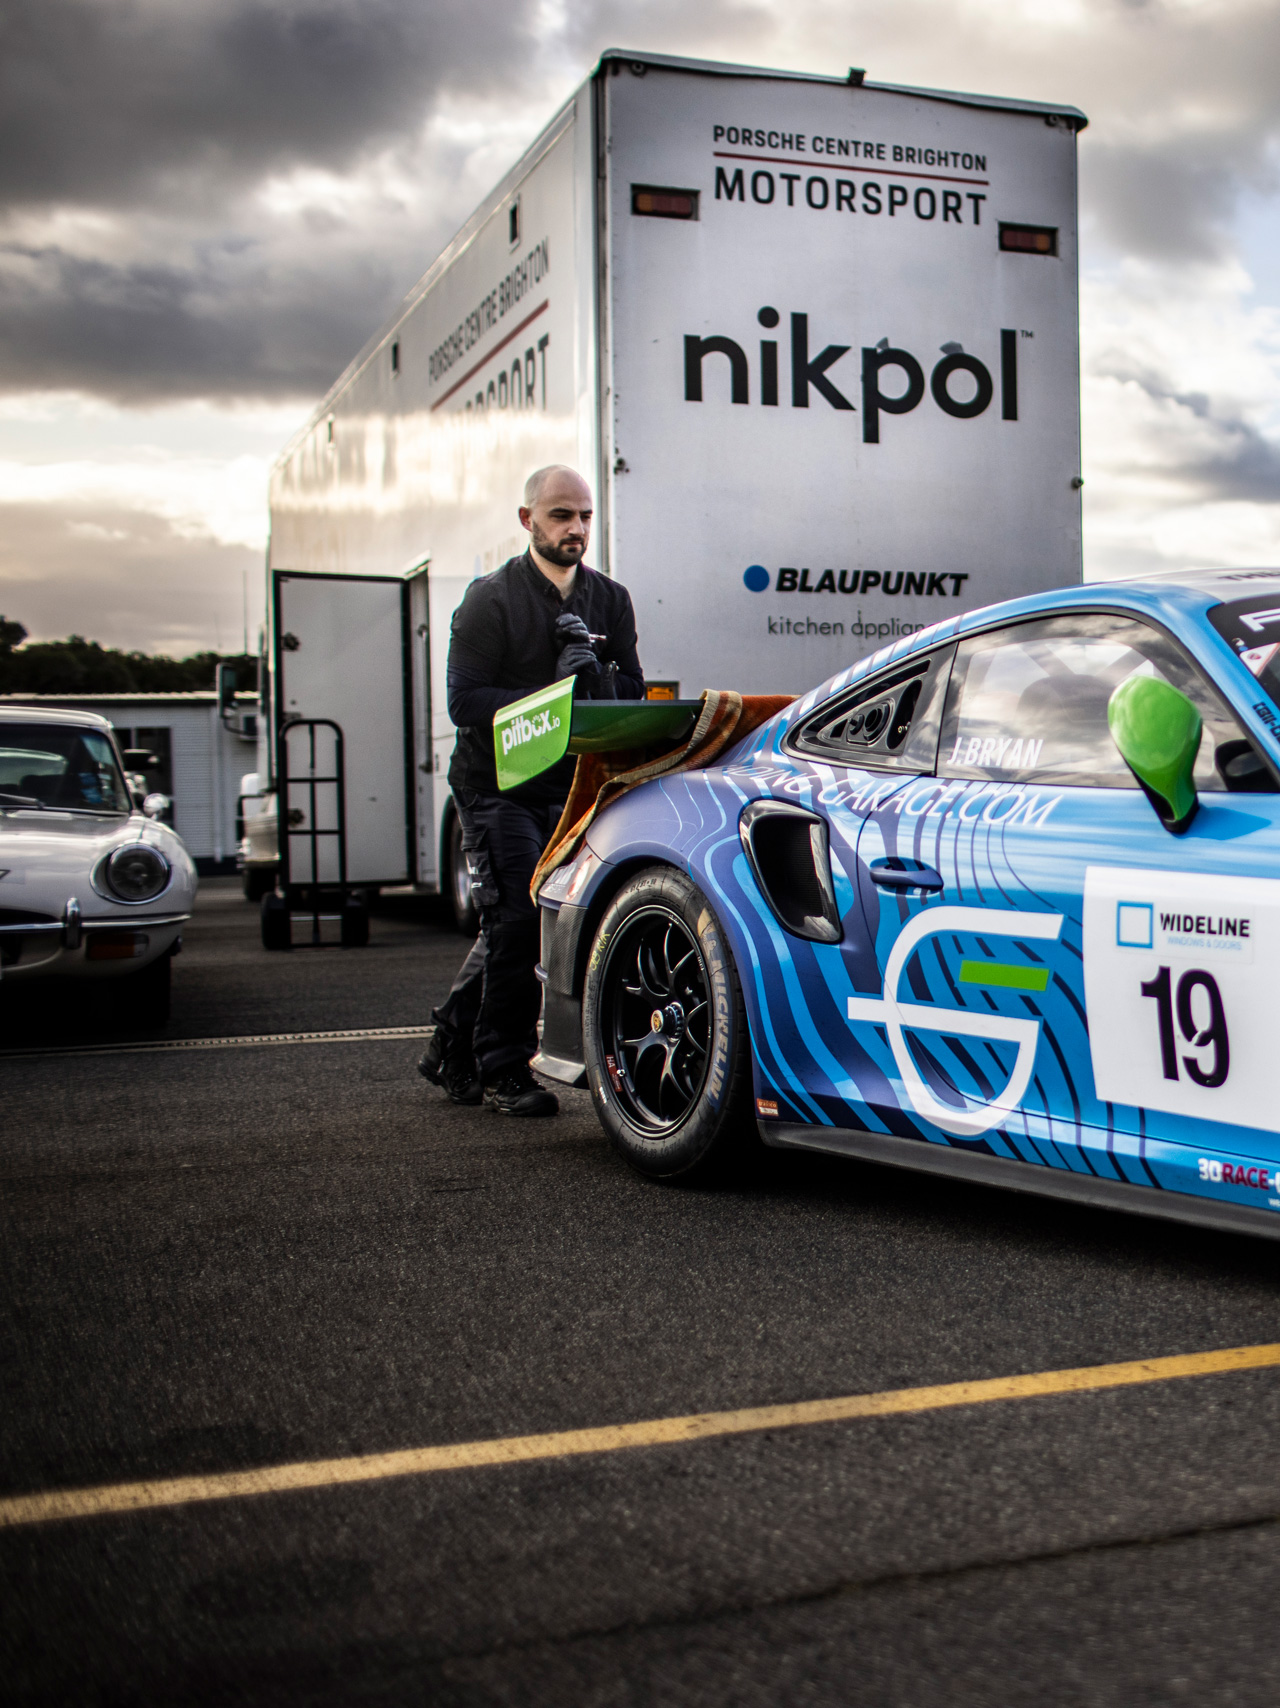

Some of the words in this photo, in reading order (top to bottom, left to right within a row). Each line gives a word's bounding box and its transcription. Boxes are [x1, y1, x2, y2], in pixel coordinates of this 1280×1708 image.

[713, 124, 806, 153] PORSCHE
[812, 135, 886, 161] CENTRE
[893, 145, 988, 172] BRIGHTON
[713, 166, 987, 226] MOTORSPORT
[683, 305, 1019, 444] nikpol
[775, 567, 969, 597] BLAUPUNKT
[767, 615, 844, 636] kitchen
[851, 616, 934, 639] applian
[946, 736, 1044, 769] J.BRYAN
[1159, 912, 1251, 938] WIDELINE
[1140, 964, 1230, 1089] 19
